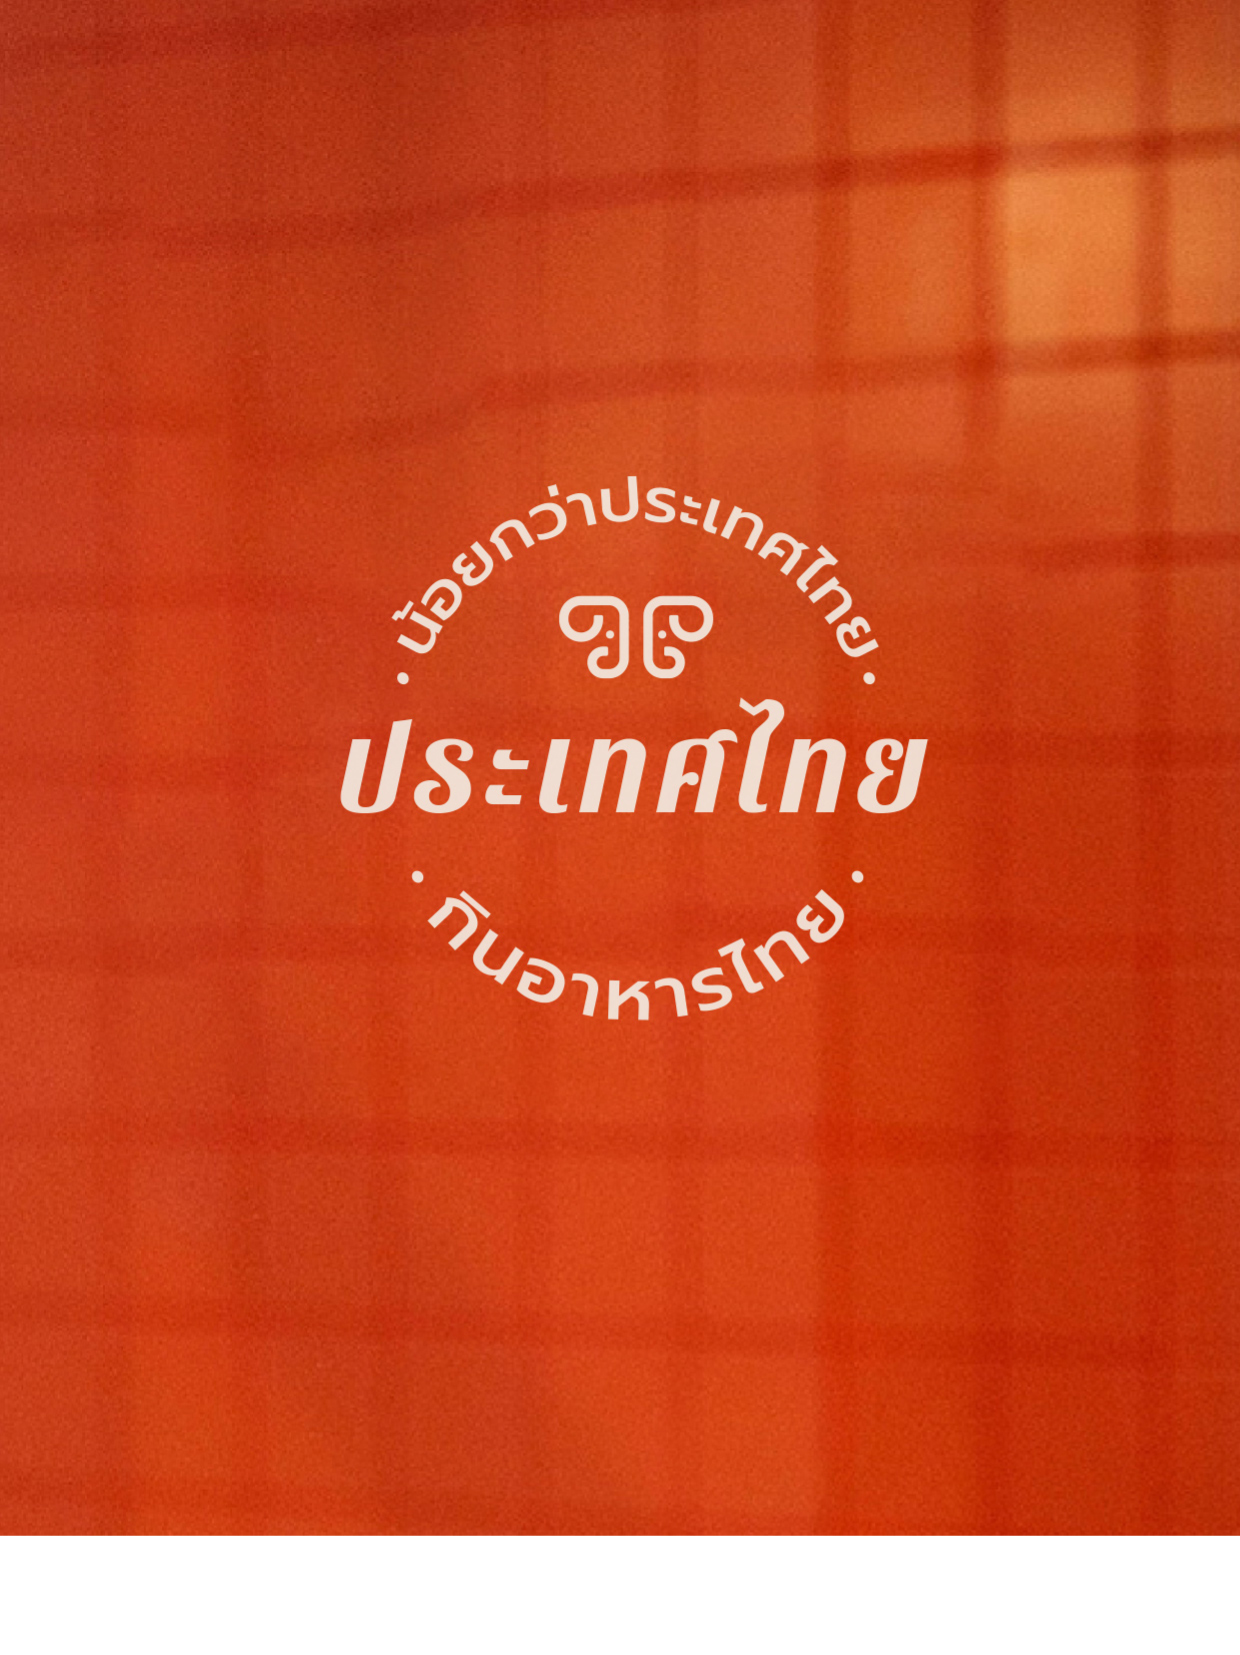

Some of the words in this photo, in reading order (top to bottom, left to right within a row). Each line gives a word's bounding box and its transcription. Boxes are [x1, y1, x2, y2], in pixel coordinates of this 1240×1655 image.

[392, 476, 879, 655] น้อยกว่าประเทศไทย
[340, 698, 928, 814] ประเทศไทย
[428, 889, 845, 1021] กินอาหารไทย
